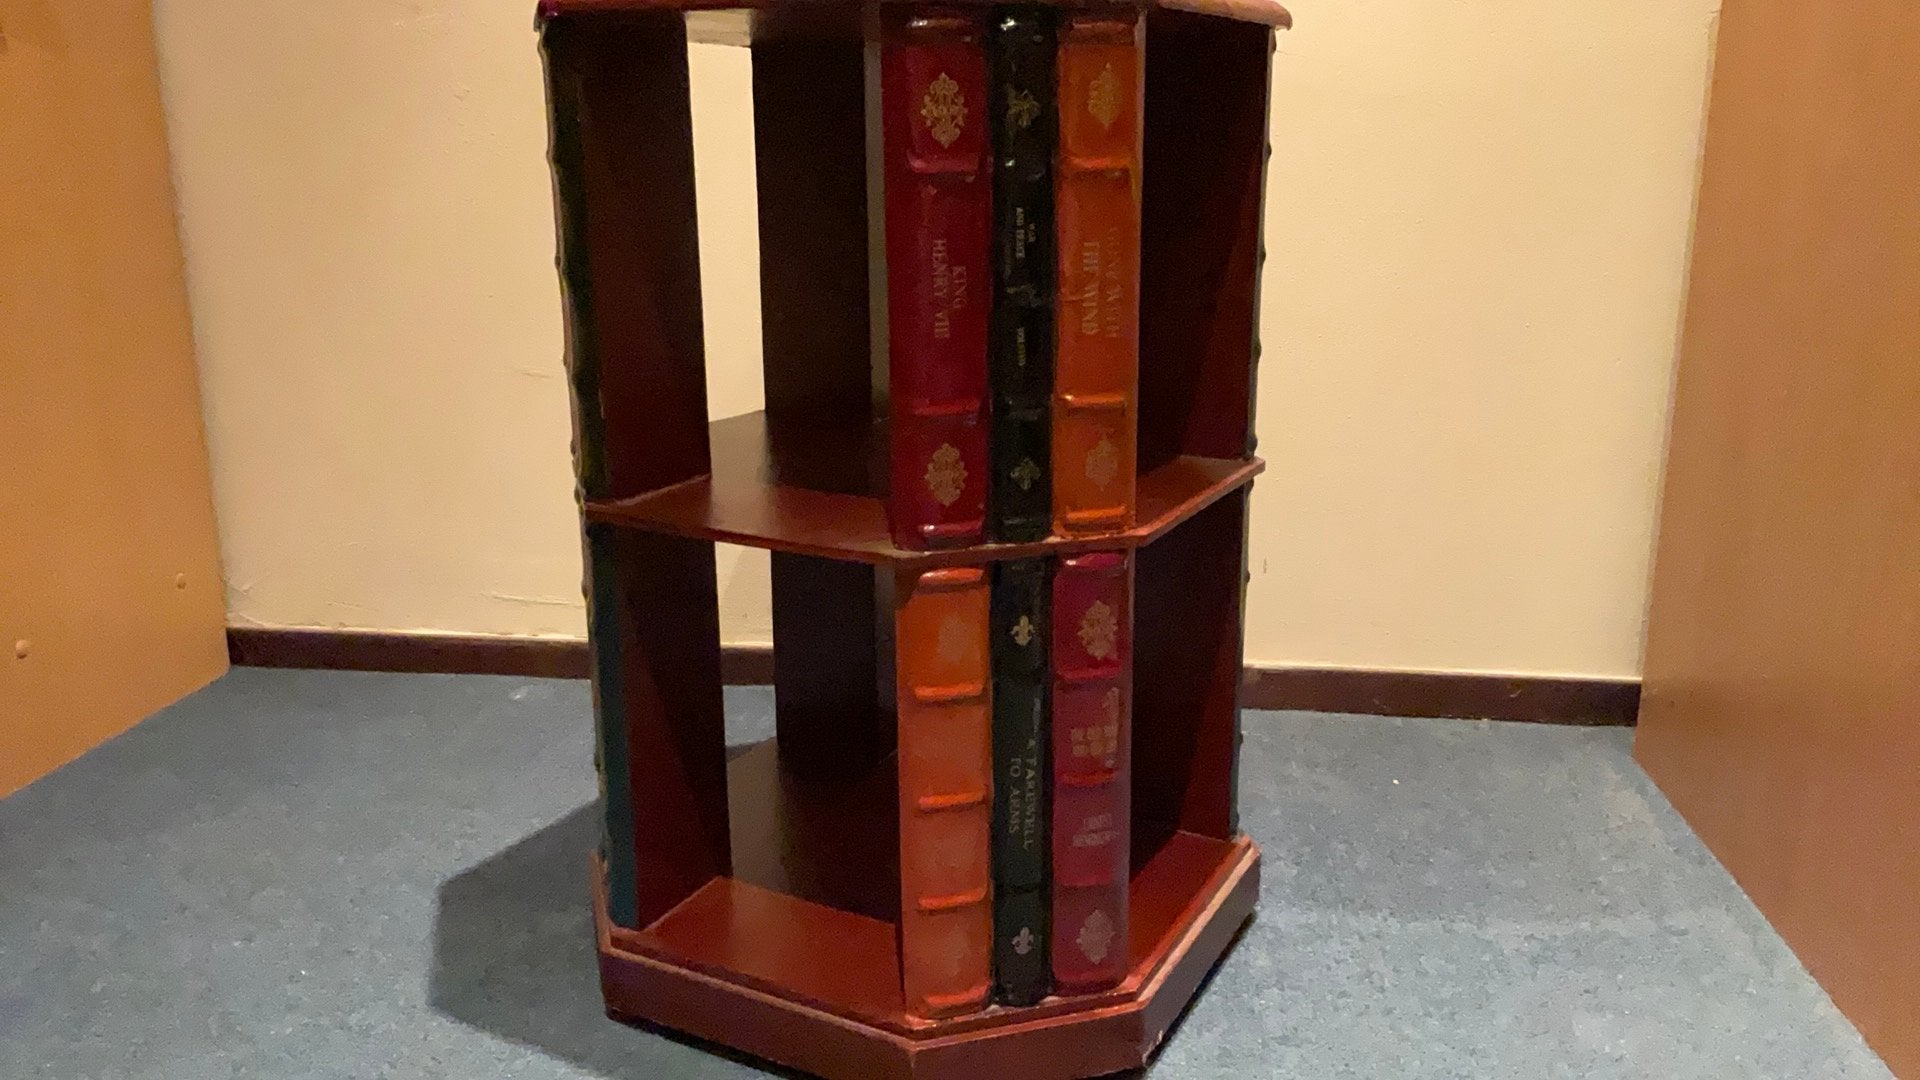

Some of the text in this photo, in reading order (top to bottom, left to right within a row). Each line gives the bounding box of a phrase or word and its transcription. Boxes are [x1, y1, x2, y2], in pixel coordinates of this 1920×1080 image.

[932, 239, 948, 299] HENRY
[952, 265, 967, 309] KING
[1082, 241, 1101, 336] THE WIND
[1009, 757, 1022, 834] TO ARMS
[1022, 756, 1037, 851] FAREWELL
